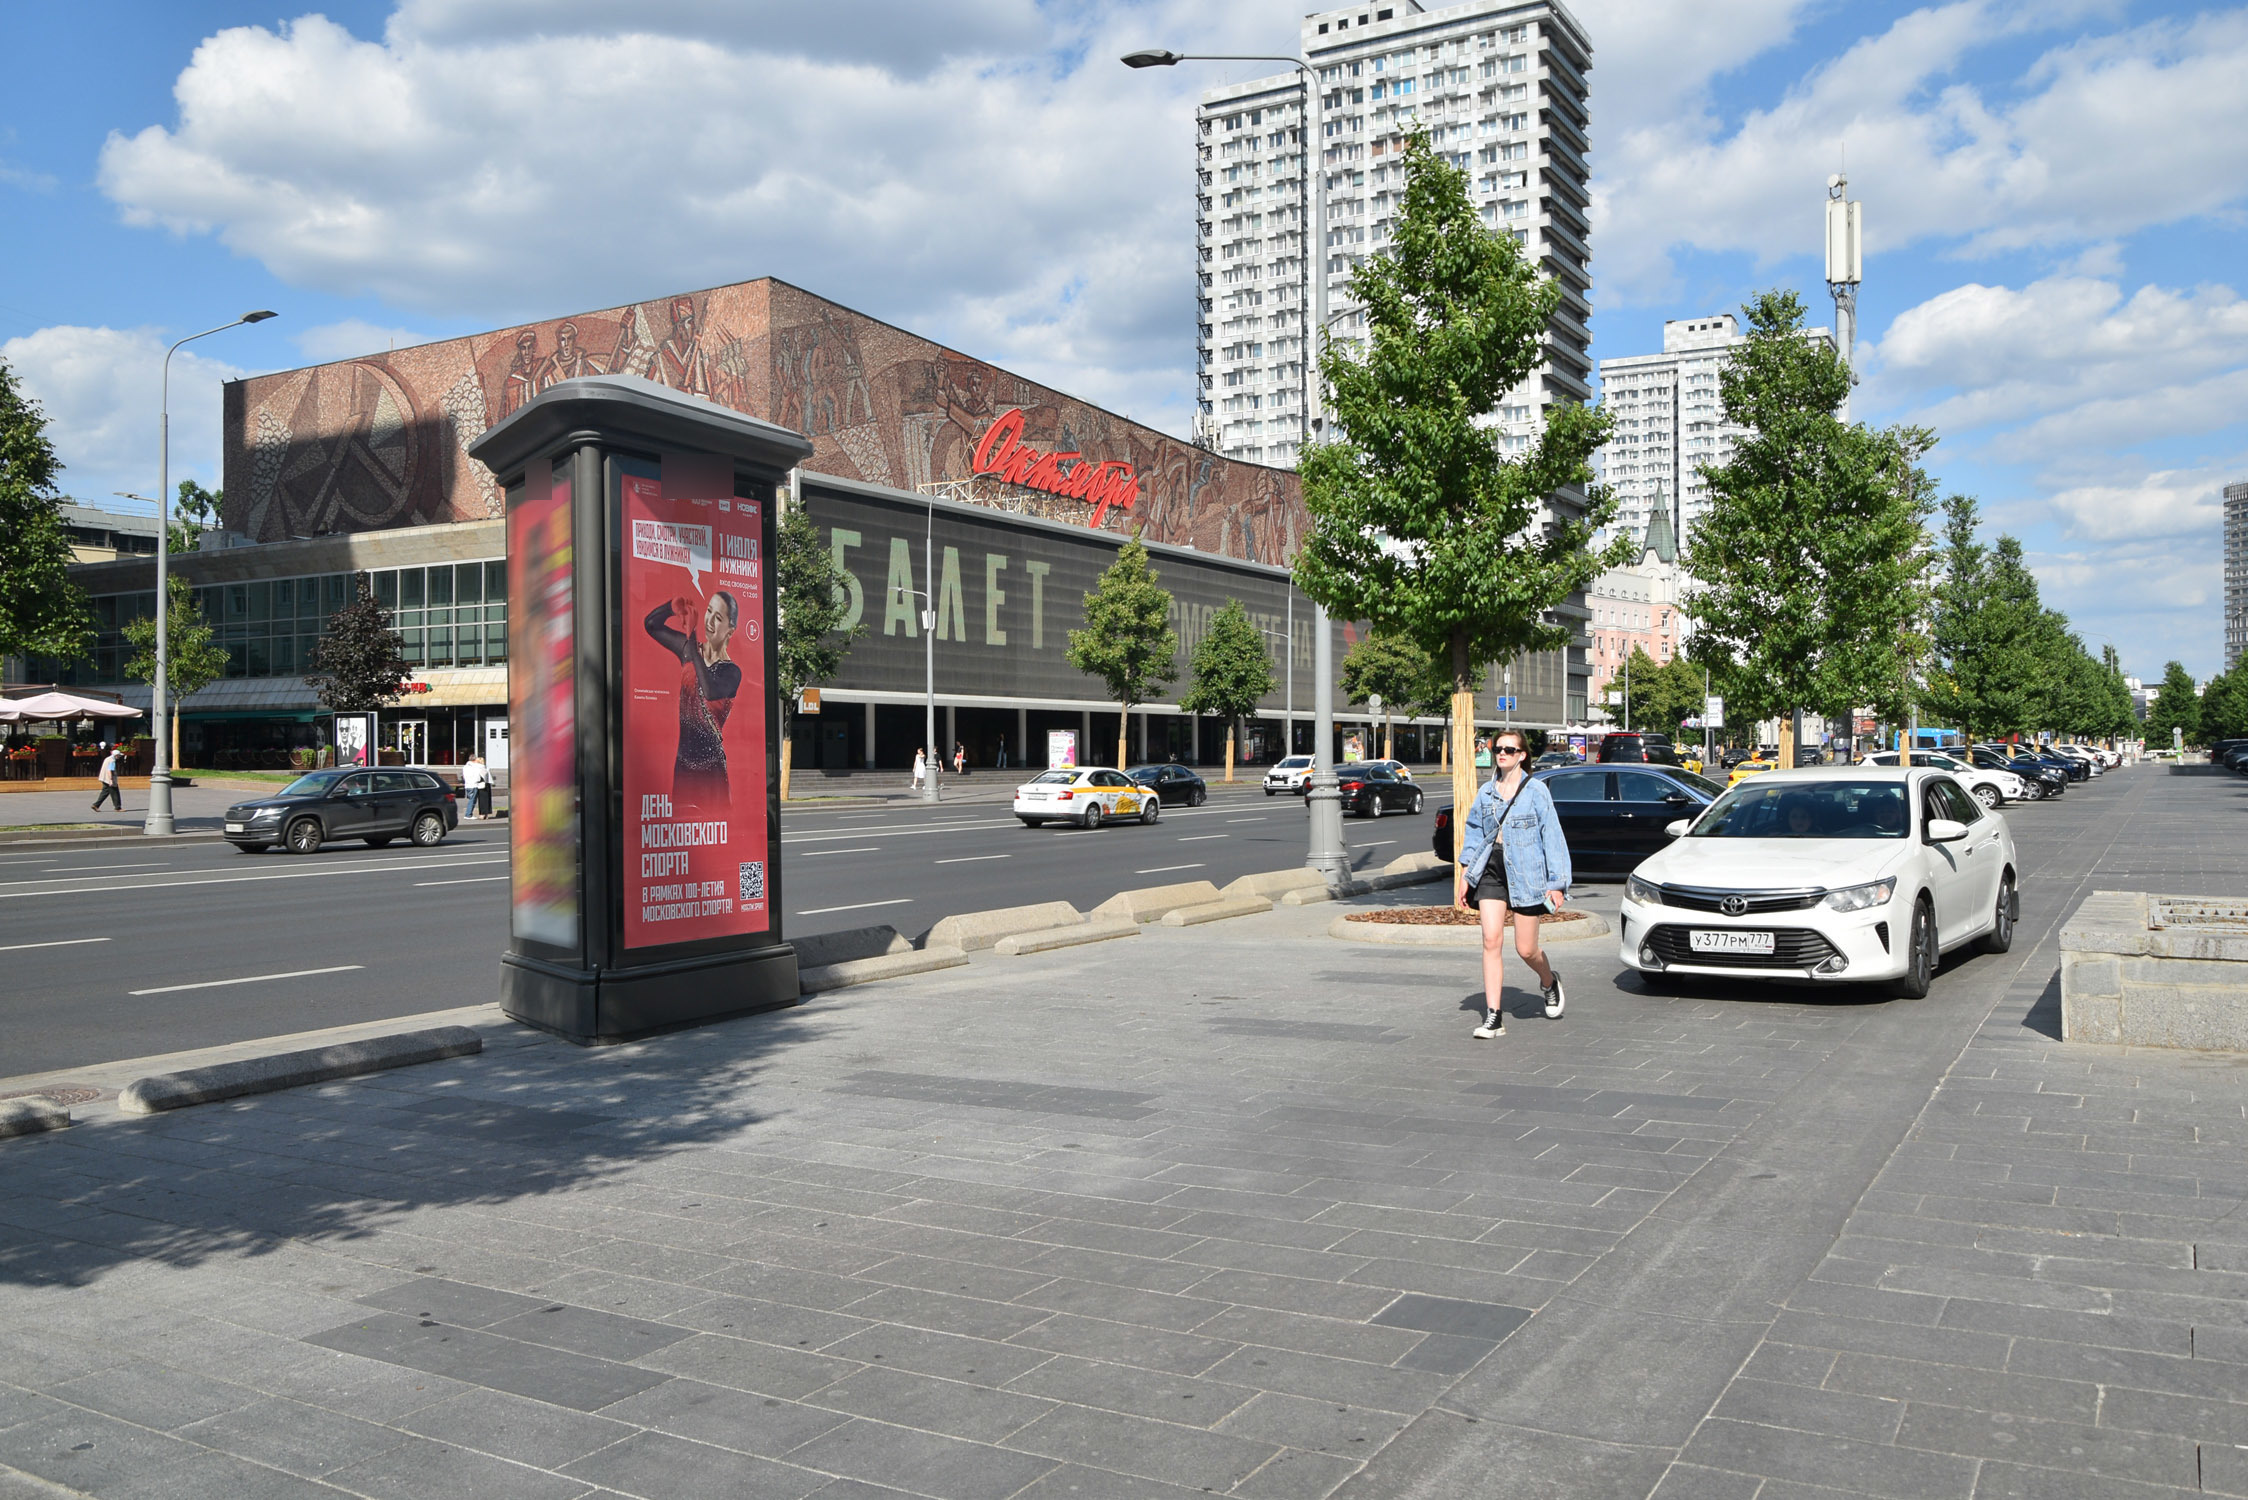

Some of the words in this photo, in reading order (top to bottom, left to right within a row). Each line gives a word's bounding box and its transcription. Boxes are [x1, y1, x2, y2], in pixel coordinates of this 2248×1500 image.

[973, 408, 1140, 528] Октябрь
[660, 543, 664, 559] В
[719, 533, 723, 555] 1
[726, 534, 757, 560] ИЮЛЯ
[719, 557, 757, 578] ЛУЖНИКИ
[720, 579, 731, 587] ВХОД
[732, 581, 757, 590] СВОБОДНЫЙ
[831, 527, 1050, 649] БАЛЕТ
[641, 794, 673, 821] ДЕНЬ
[641, 821, 728, 849] МОСКОВСКОГО
[641, 851, 689, 878] СПОРТА
[642, 886, 648, 903] В
[650, 883, 683, 902] РАМКАХ
[685, 880, 724, 899] 100-ЛЕТИЯ
[642, 901, 700, 923] МОСКОВСКОГО
[702, 898, 733, 917] СПОРТА!
[1749, 934, 1769, 944] 777
